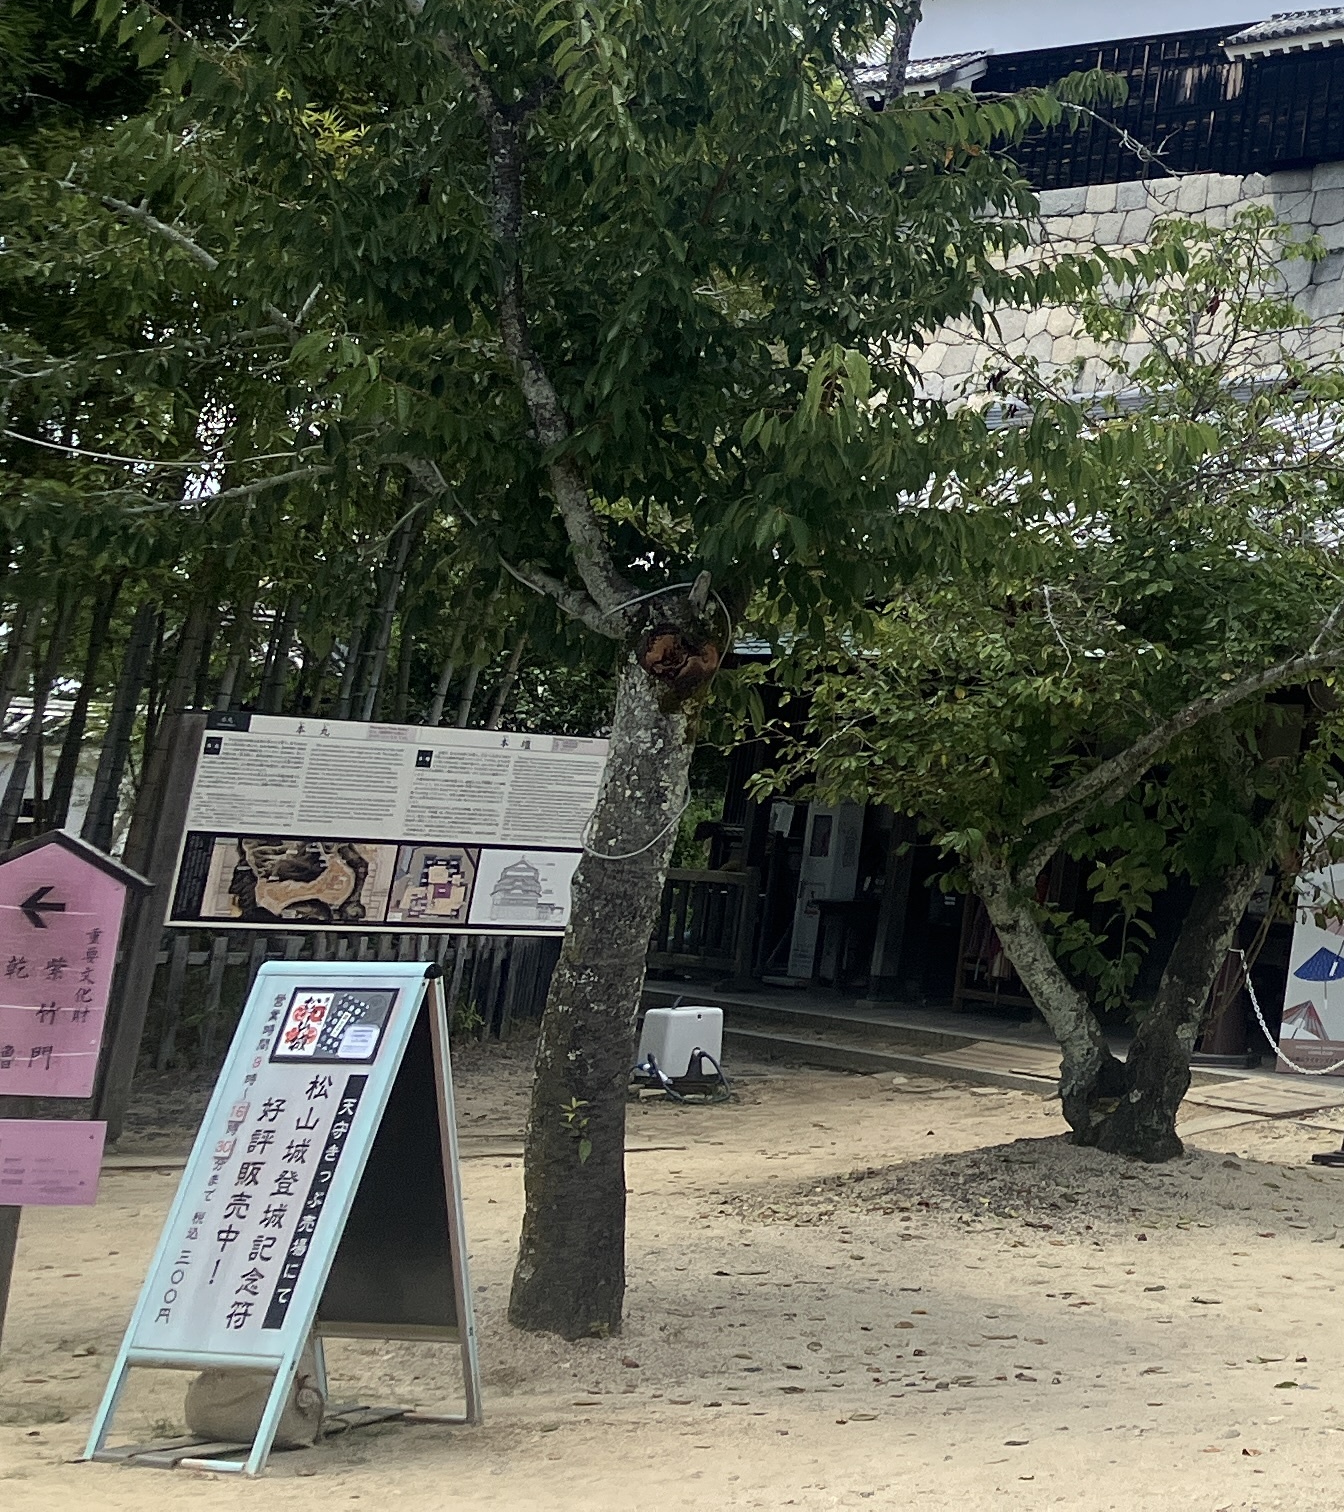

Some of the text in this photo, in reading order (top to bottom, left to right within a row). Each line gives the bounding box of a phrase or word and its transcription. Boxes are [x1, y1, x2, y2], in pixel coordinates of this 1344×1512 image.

[27, 957, 69, 1071] 紫竹門
[71, 928, 103, 1024] 重要文化財
[208, 1096, 287, 1286] 好評販売中!
[225, 1074, 333, 1331] 松山城登城記念符
